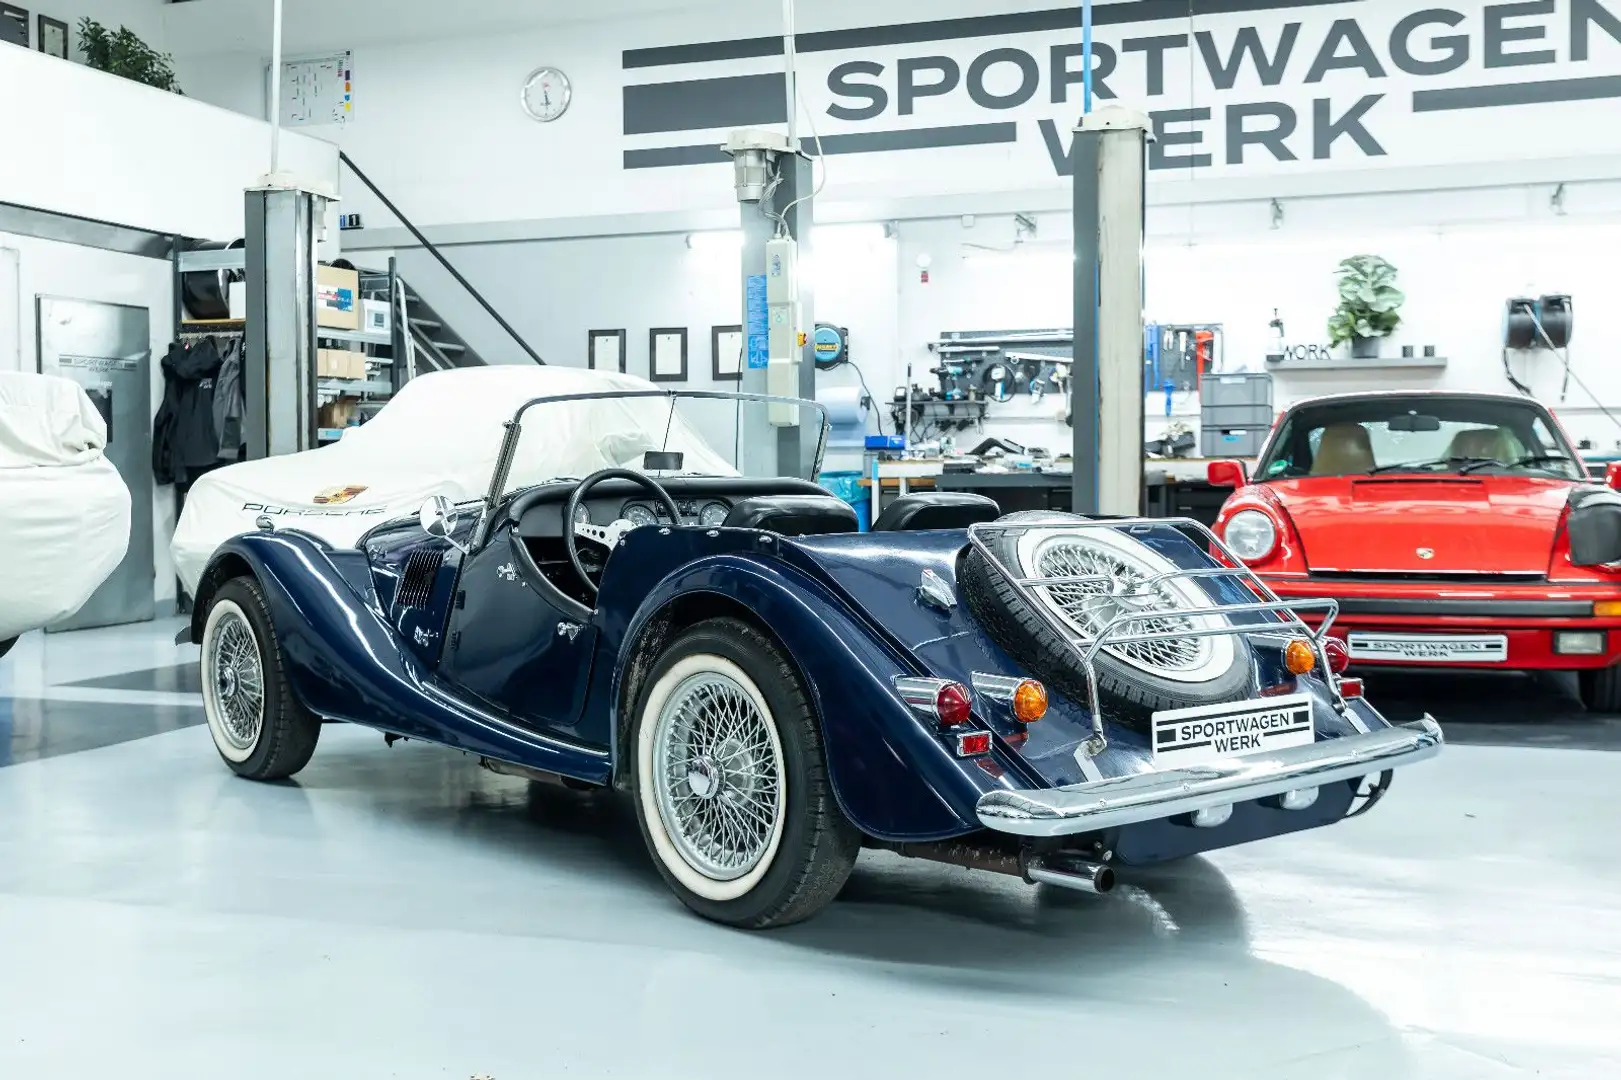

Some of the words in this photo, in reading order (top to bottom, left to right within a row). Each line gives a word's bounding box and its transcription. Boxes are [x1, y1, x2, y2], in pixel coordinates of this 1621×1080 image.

[242, 502, 388, 517] PORSCHE
[1372, 642, 1482, 650] SPORTWAGEN
[1181, 712, 1290, 741] SPORTWAGEN
[1214, 734, 1261, 753] WERK
